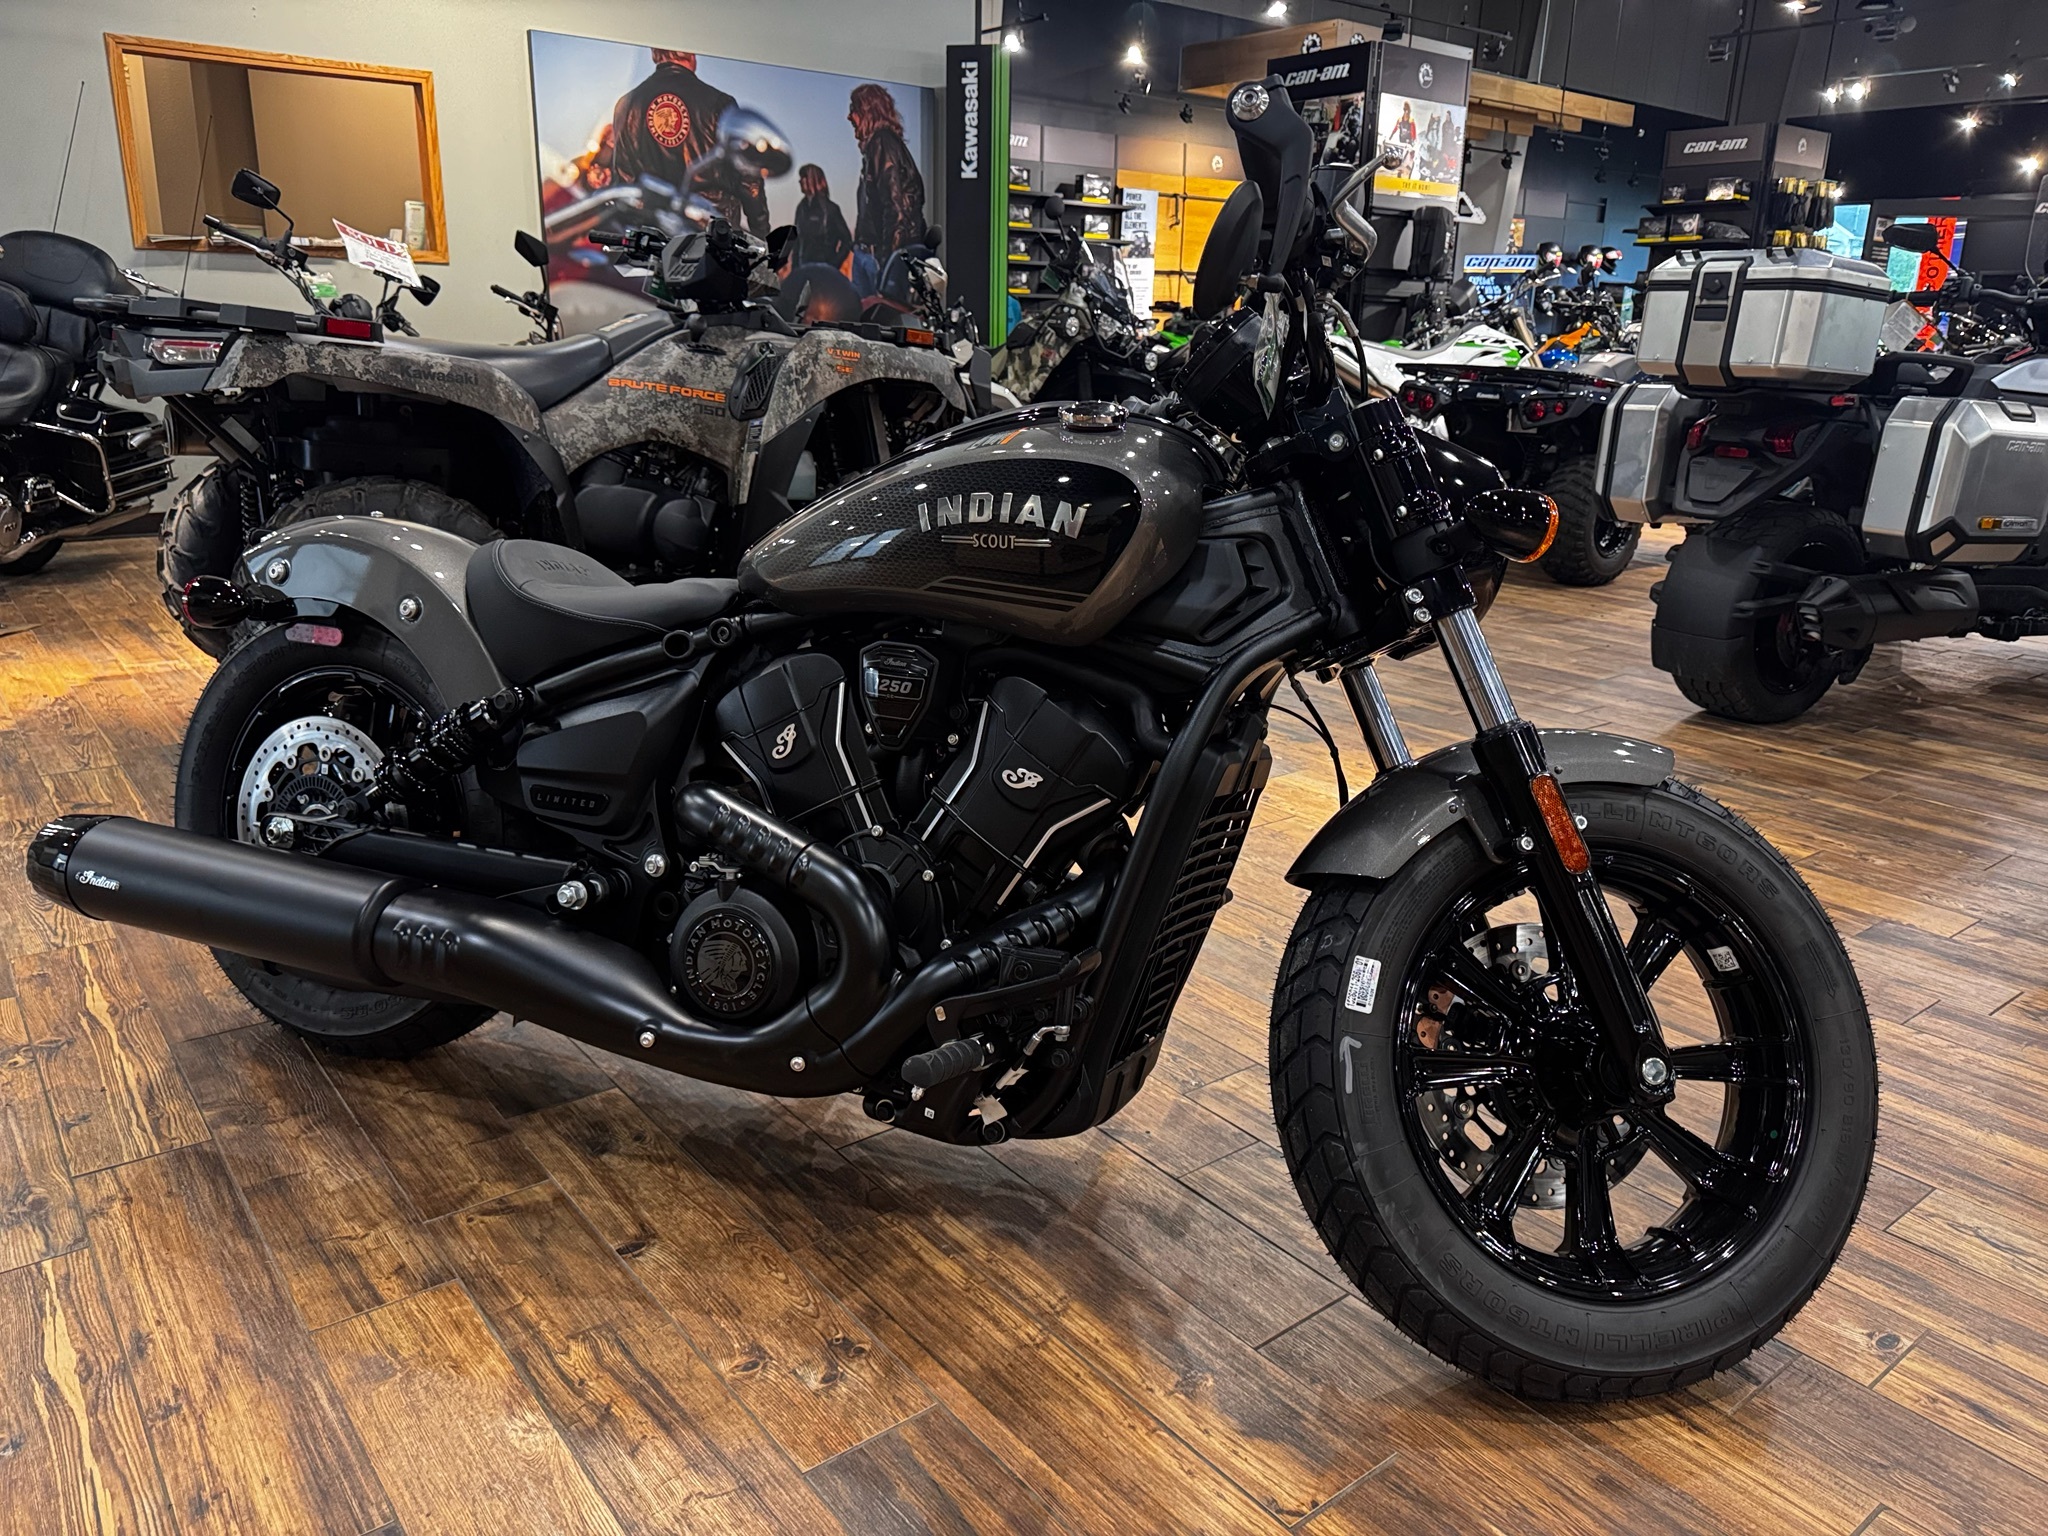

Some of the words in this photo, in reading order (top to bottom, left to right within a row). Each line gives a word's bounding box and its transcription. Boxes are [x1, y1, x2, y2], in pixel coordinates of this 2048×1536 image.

[1285, 62, 1350, 87] can-am
[961, 61, 979, 179] Kawasaki
[1684, 137, 1748, 154] can-am
[1466, 257, 1535, 268] can-am
[402, 364, 479, 386] Kawasaki
[608, 378, 668, 393] BRUTE
[669, 386, 727, 403] FORCE
[917, 492, 1088, 539] INDIAN
[973, 533, 1017, 549] SCOUT
[537, 793, 596, 808] LIMITED
[77, 870, 120, 890] Indian
[686, 926, 707, 987] INDIAN
[711, 918, 767, 1000] MOTORCYCLE
[1595, 1305, 1739, 1351] PIRELLI
